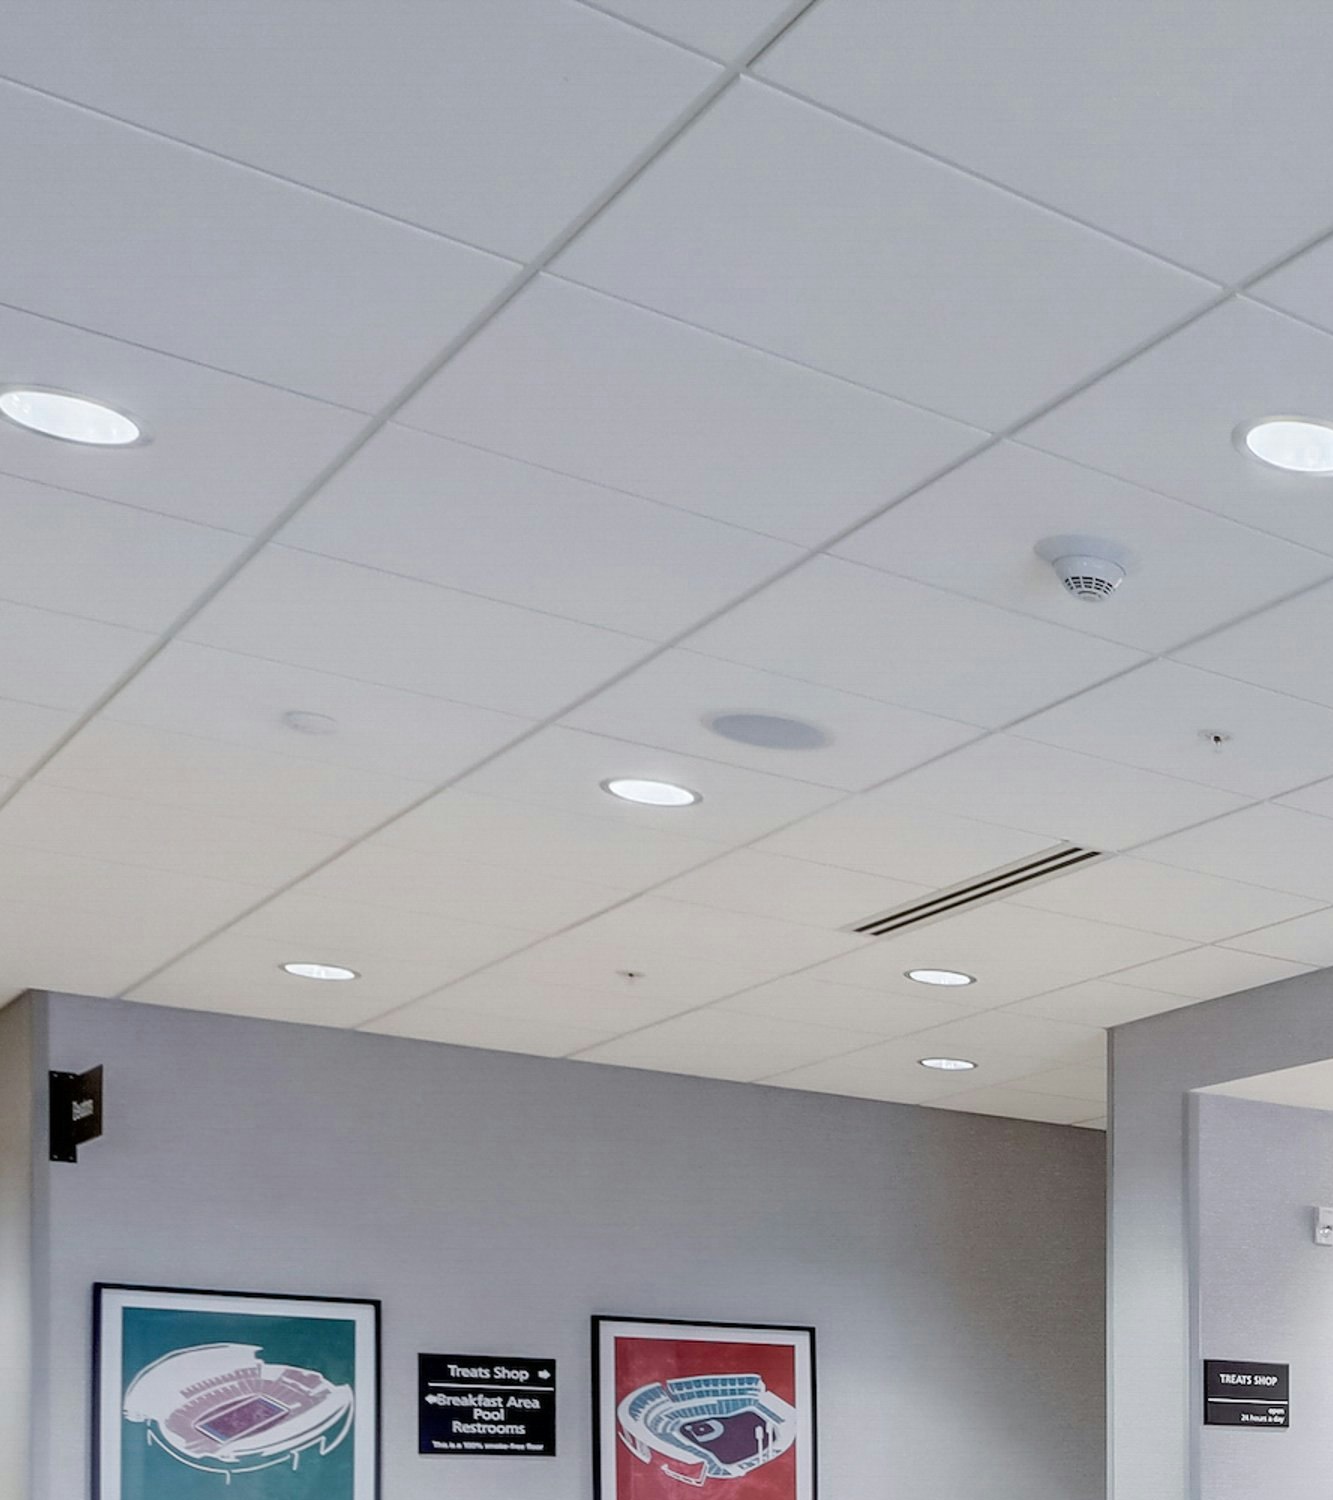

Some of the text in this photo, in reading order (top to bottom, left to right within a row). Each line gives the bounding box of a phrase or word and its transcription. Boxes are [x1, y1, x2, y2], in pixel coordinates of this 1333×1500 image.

[447, 1364, 529, 1382] Treats Shop
[1219, 1373, 1278, 1386] TREATS SHOP
[436, 1393, 541, 1409] Breakfast Area
[473, 1408, 505, 1421] Pool
[452, 1421, 526, 1434] Restrooms
